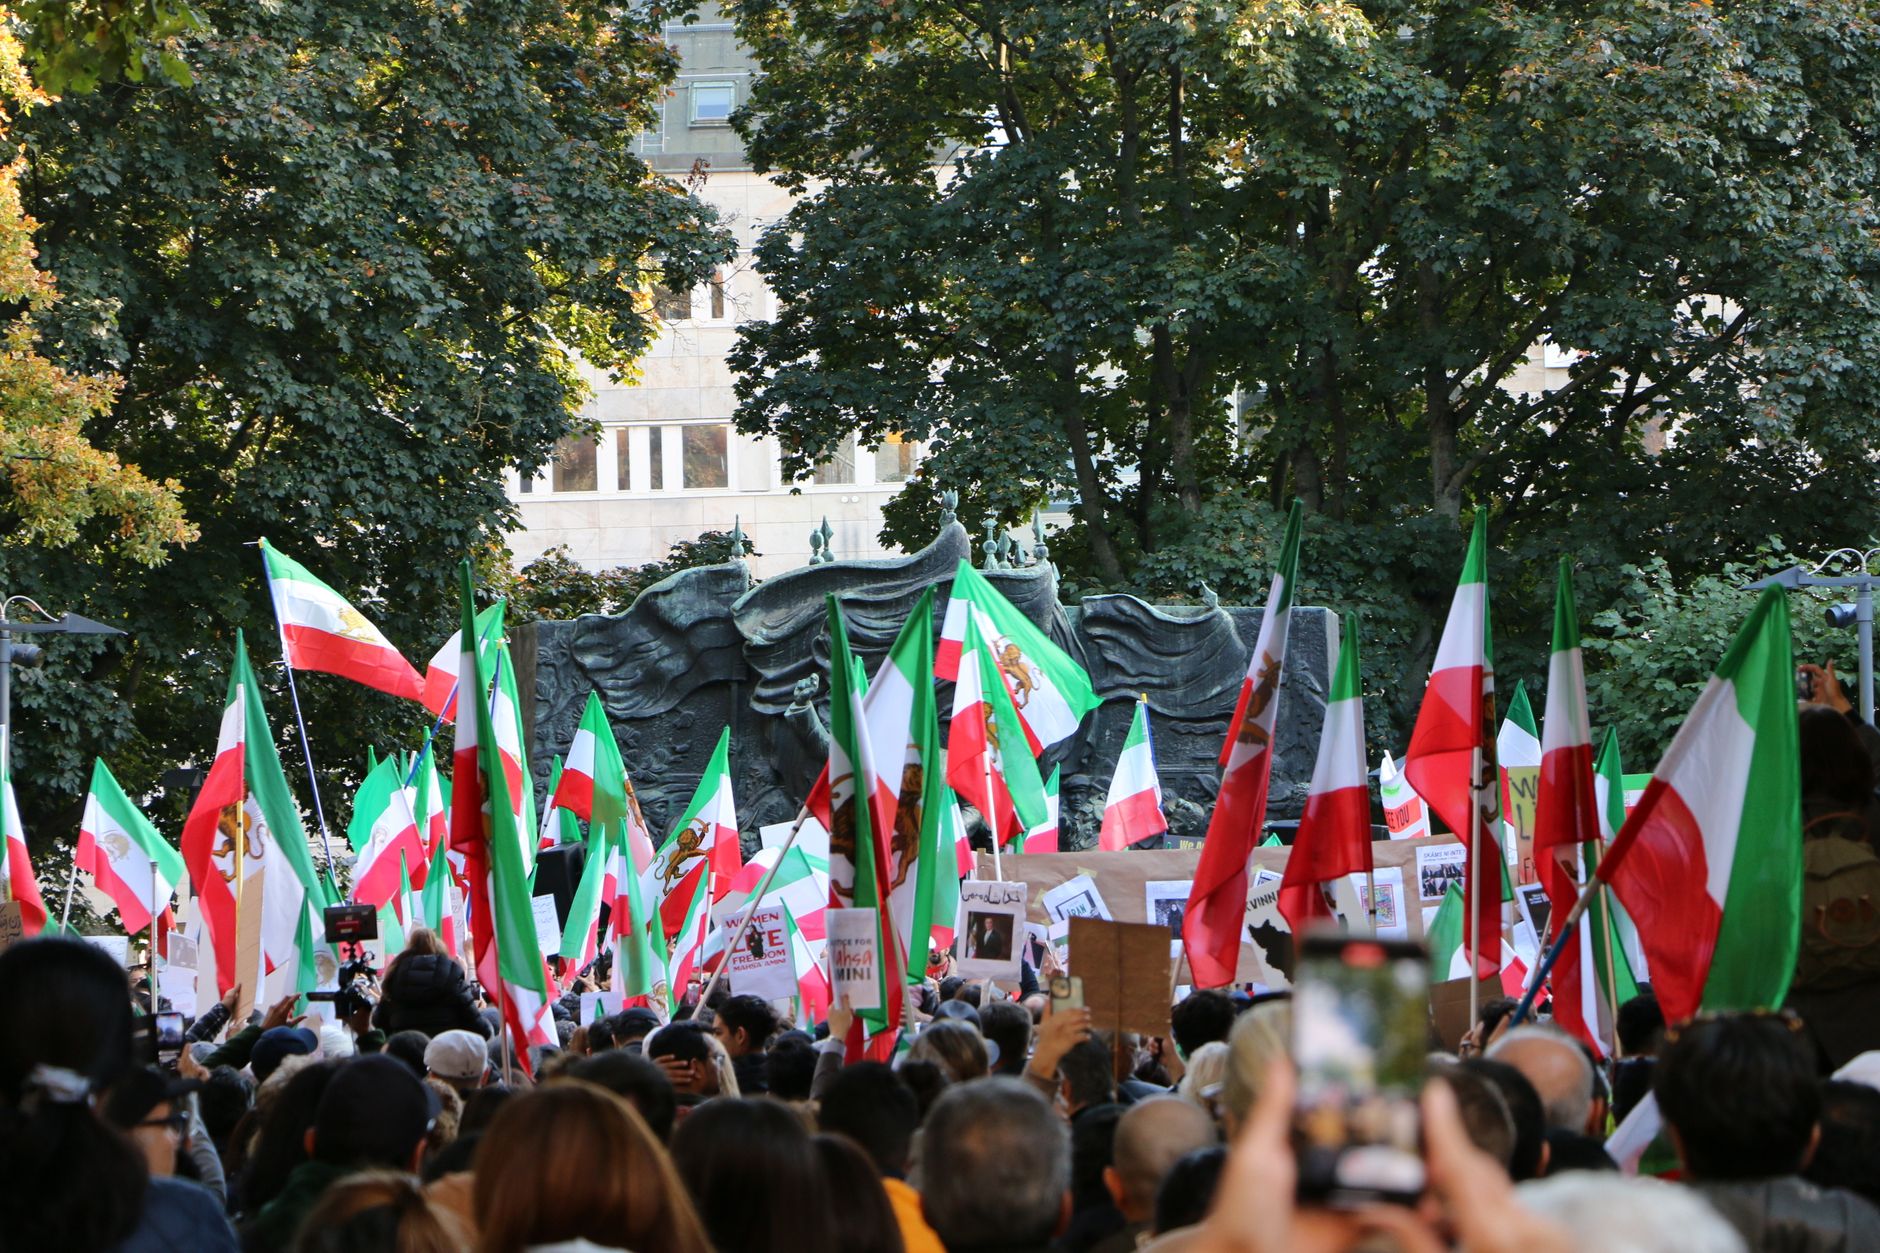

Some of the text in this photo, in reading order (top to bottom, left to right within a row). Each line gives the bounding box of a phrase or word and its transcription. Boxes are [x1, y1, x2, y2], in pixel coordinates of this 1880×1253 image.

[1395, 803, 1410, 828] YOU
[1246, 889, 1281, 912] VINN
[726, 912, 779, 929] WMEN
